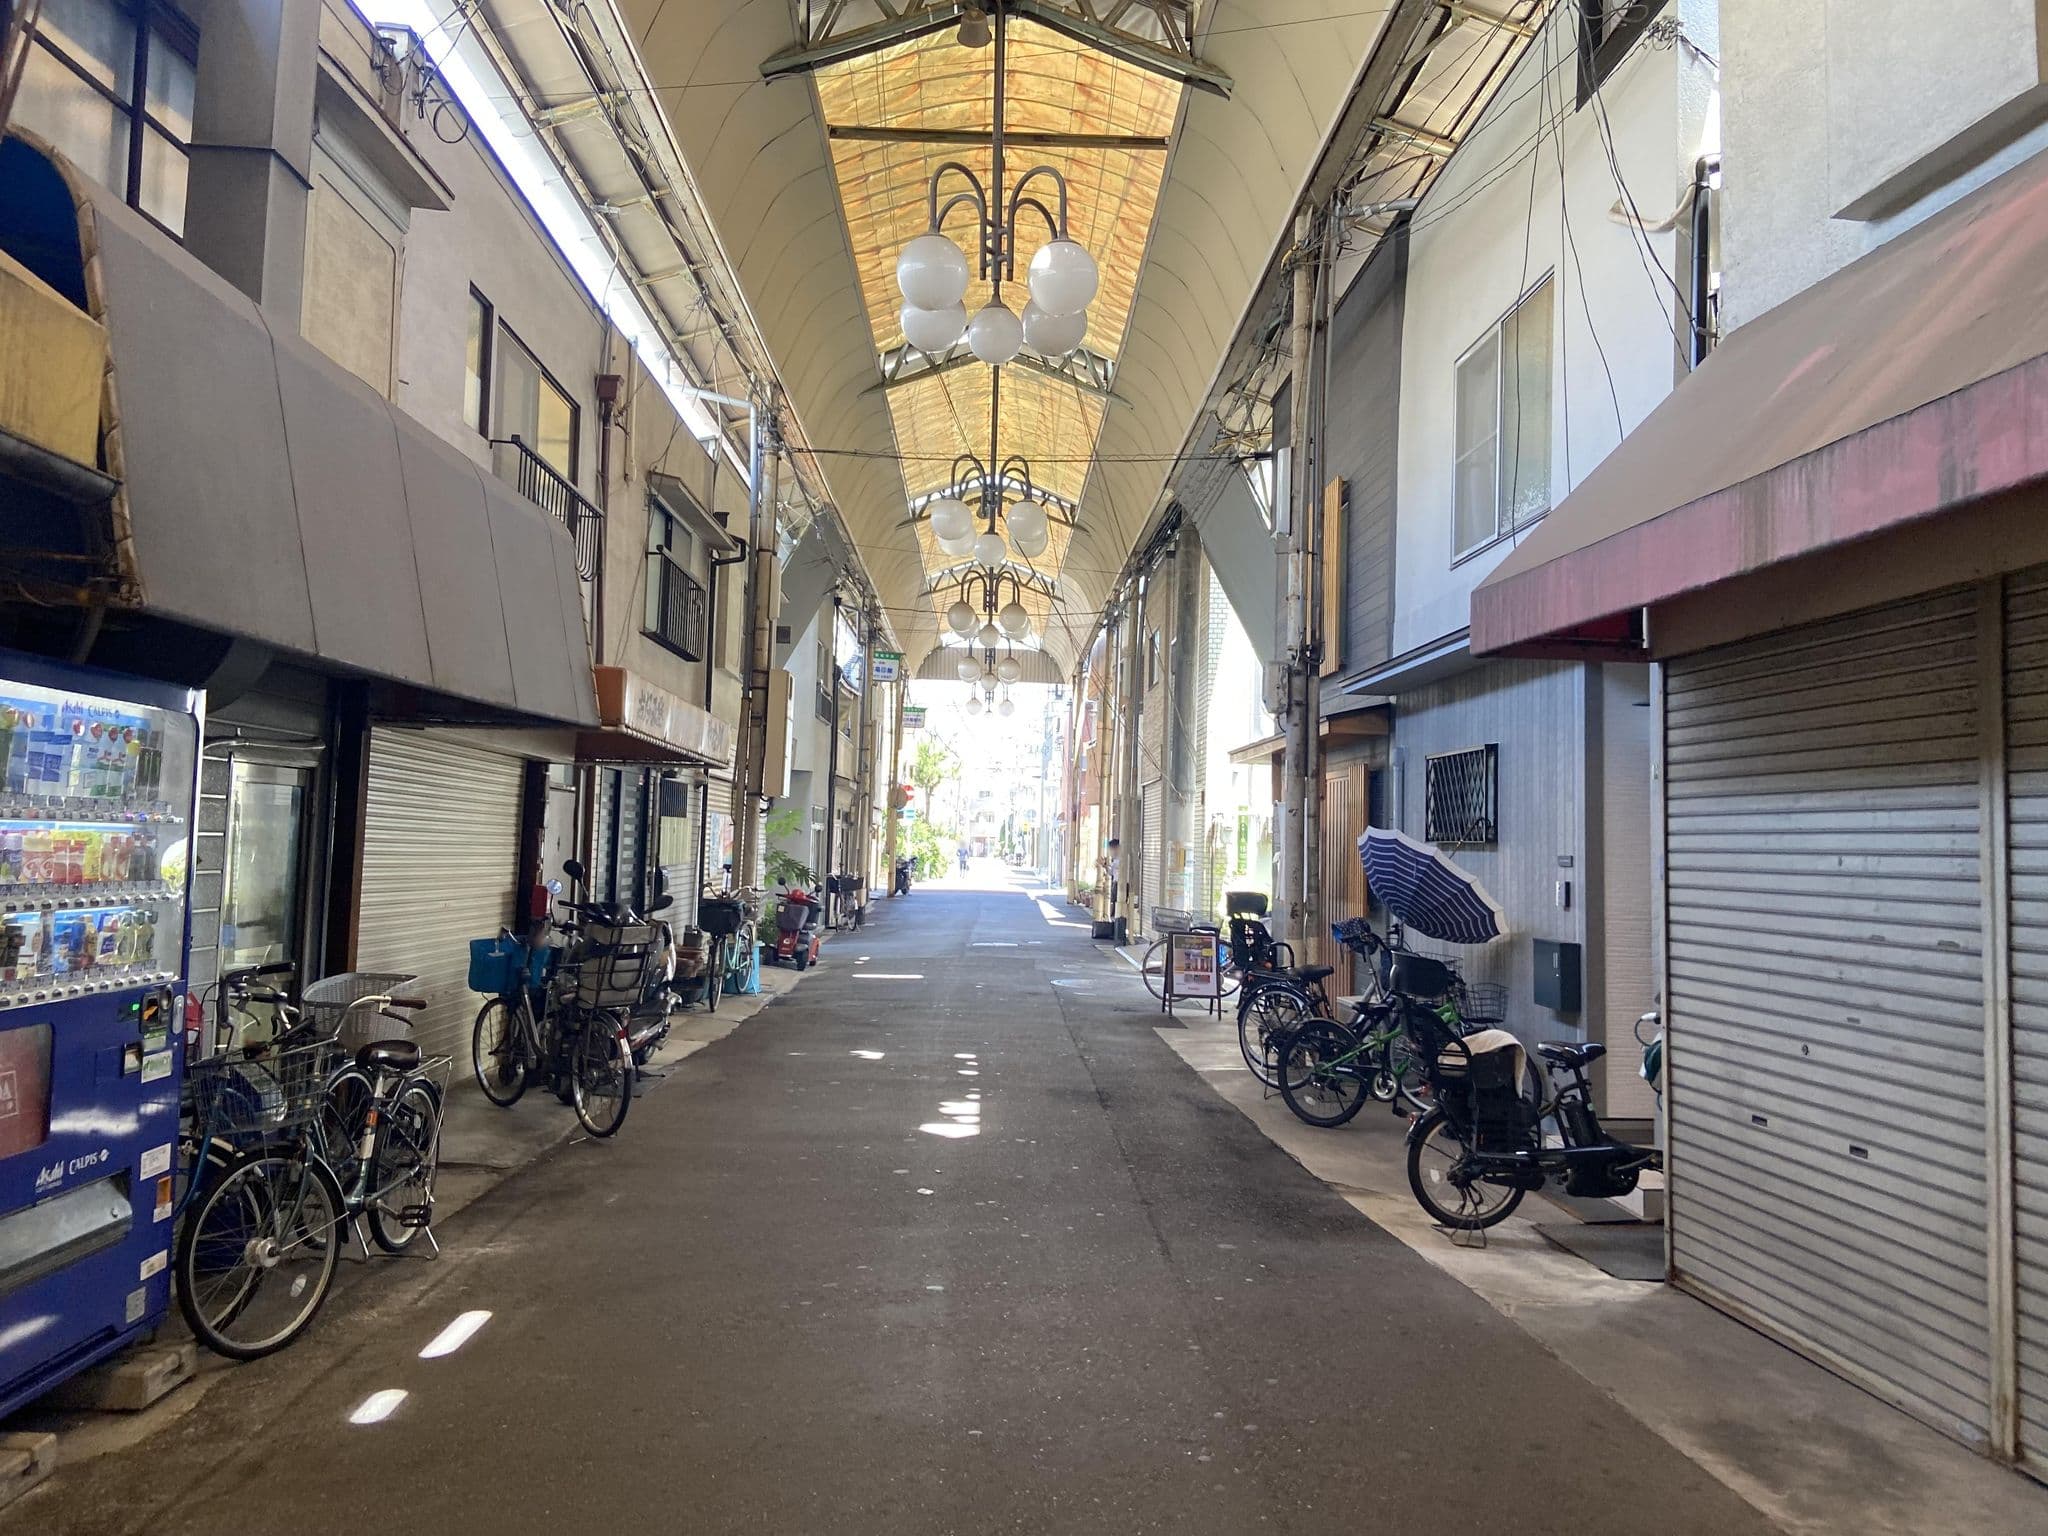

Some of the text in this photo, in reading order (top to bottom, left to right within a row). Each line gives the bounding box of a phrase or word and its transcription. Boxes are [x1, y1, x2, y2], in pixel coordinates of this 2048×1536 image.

[62, 699, 113, 718] Asahi CALPIS
[35, 1161, 64, 1187] Asahi
[69, 1152, 98, 1175] CALPIS
